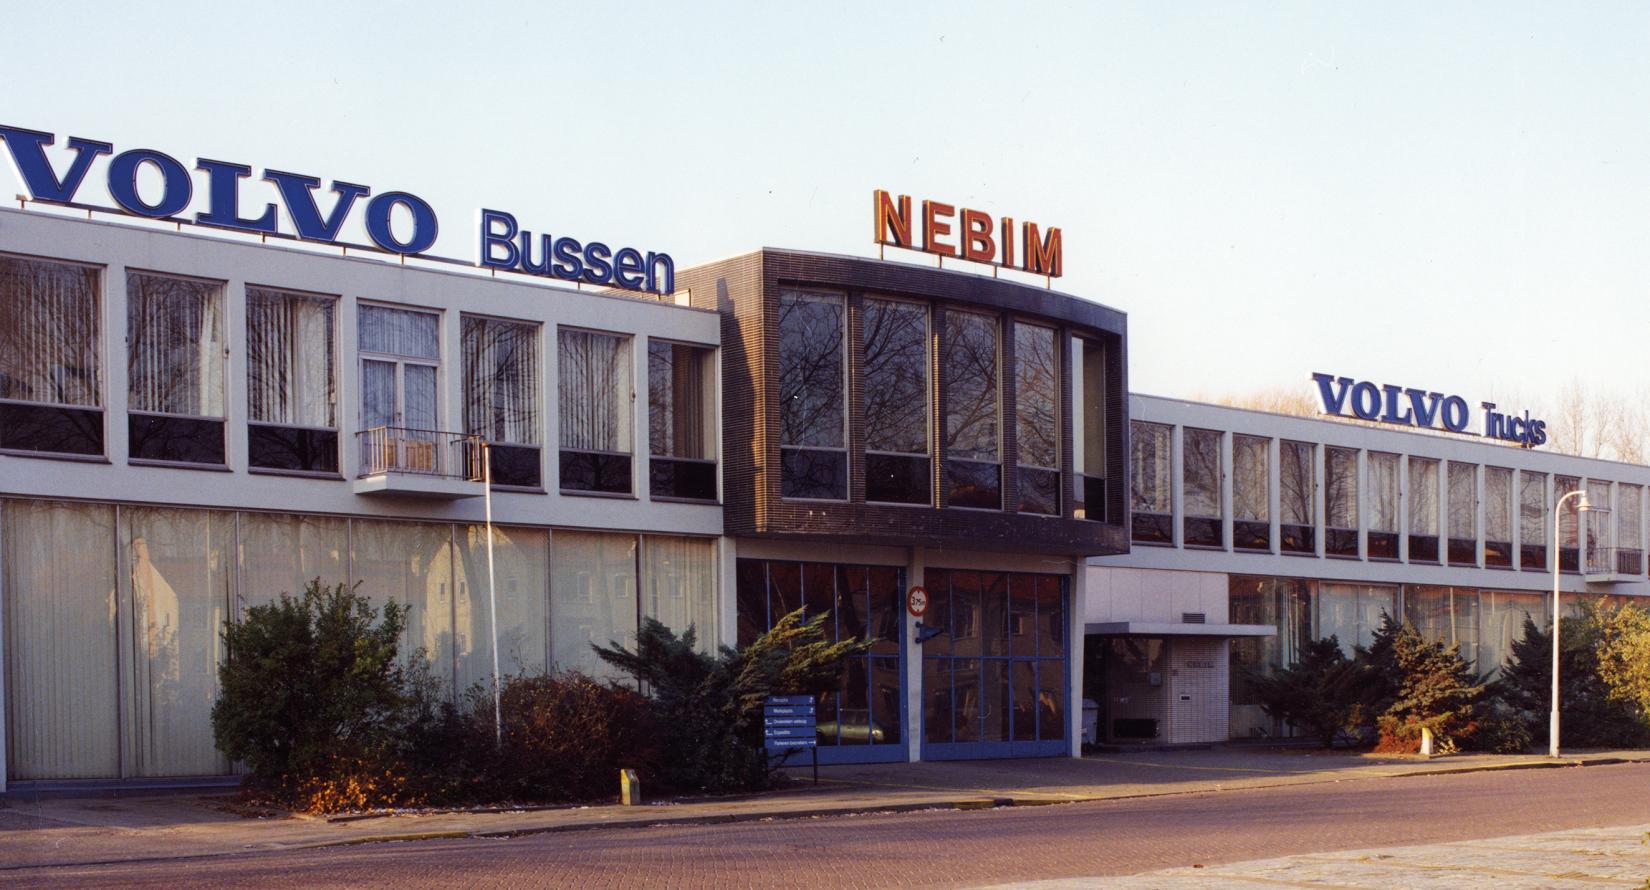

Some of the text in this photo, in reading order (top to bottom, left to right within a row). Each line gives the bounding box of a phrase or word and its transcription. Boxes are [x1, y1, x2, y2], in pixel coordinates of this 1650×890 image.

[0, 125, 675, 294] VOLVO Bussen
[874, 189, 1062, 278] NEBIM
[1310, 372, 1547, 446] VOLVO Trucks
